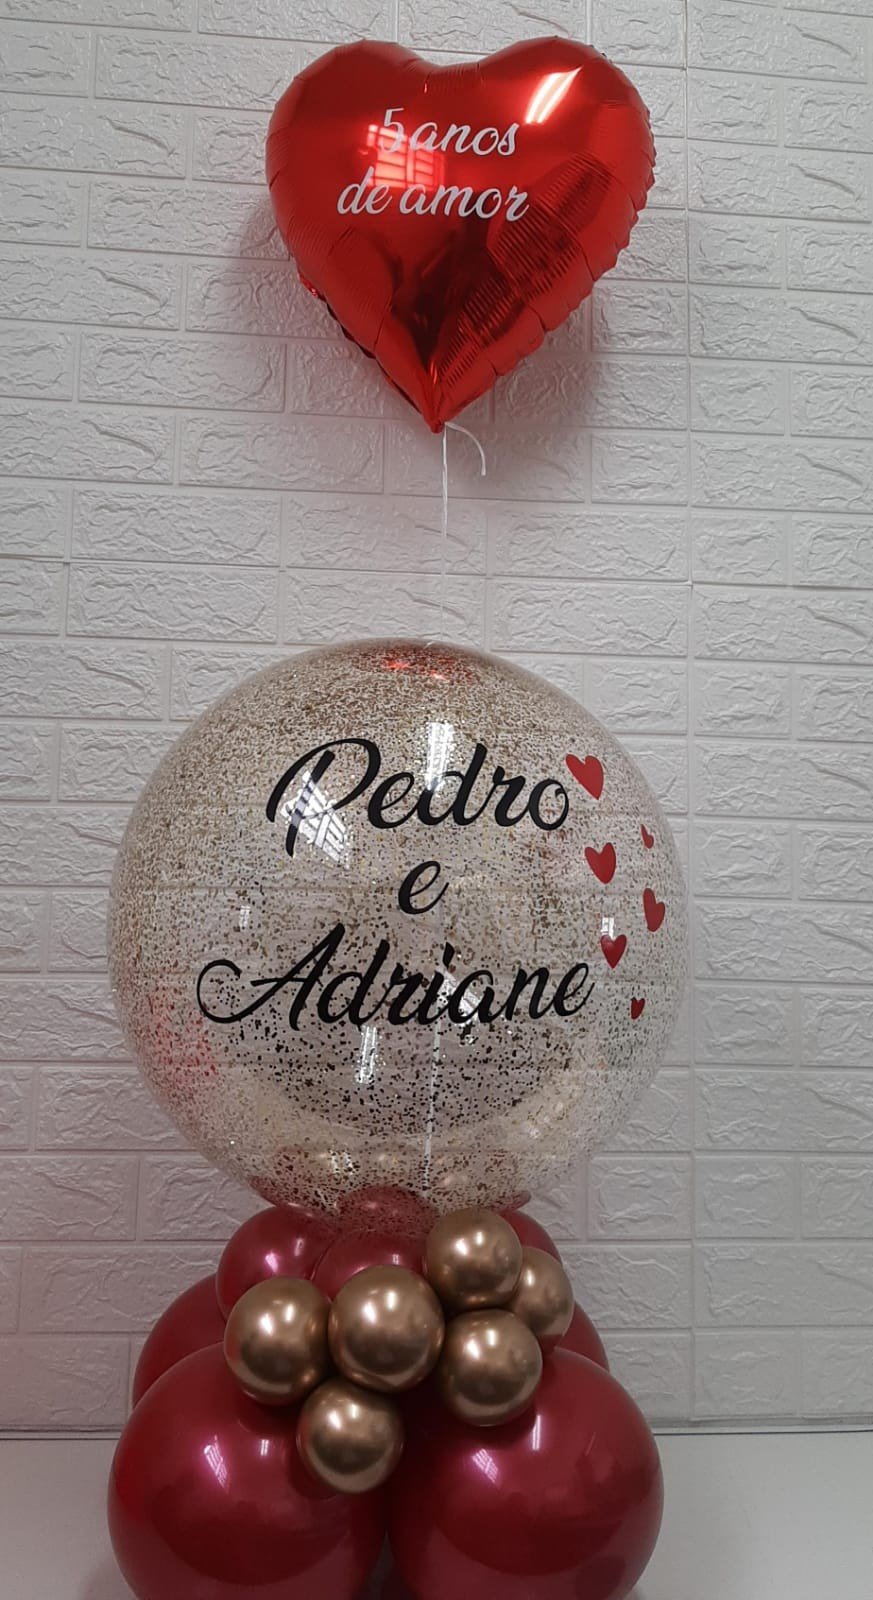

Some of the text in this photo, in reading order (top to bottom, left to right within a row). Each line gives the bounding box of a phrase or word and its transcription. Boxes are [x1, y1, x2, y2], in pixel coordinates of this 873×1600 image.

[377, 107, 520, 156] 5 anos
[336, 165, 530, 222] de amor
[265, 737, 570, 858] Pedro
[398, 860, 450, 915] e
[196, 922, 596, 1031] Adriane
